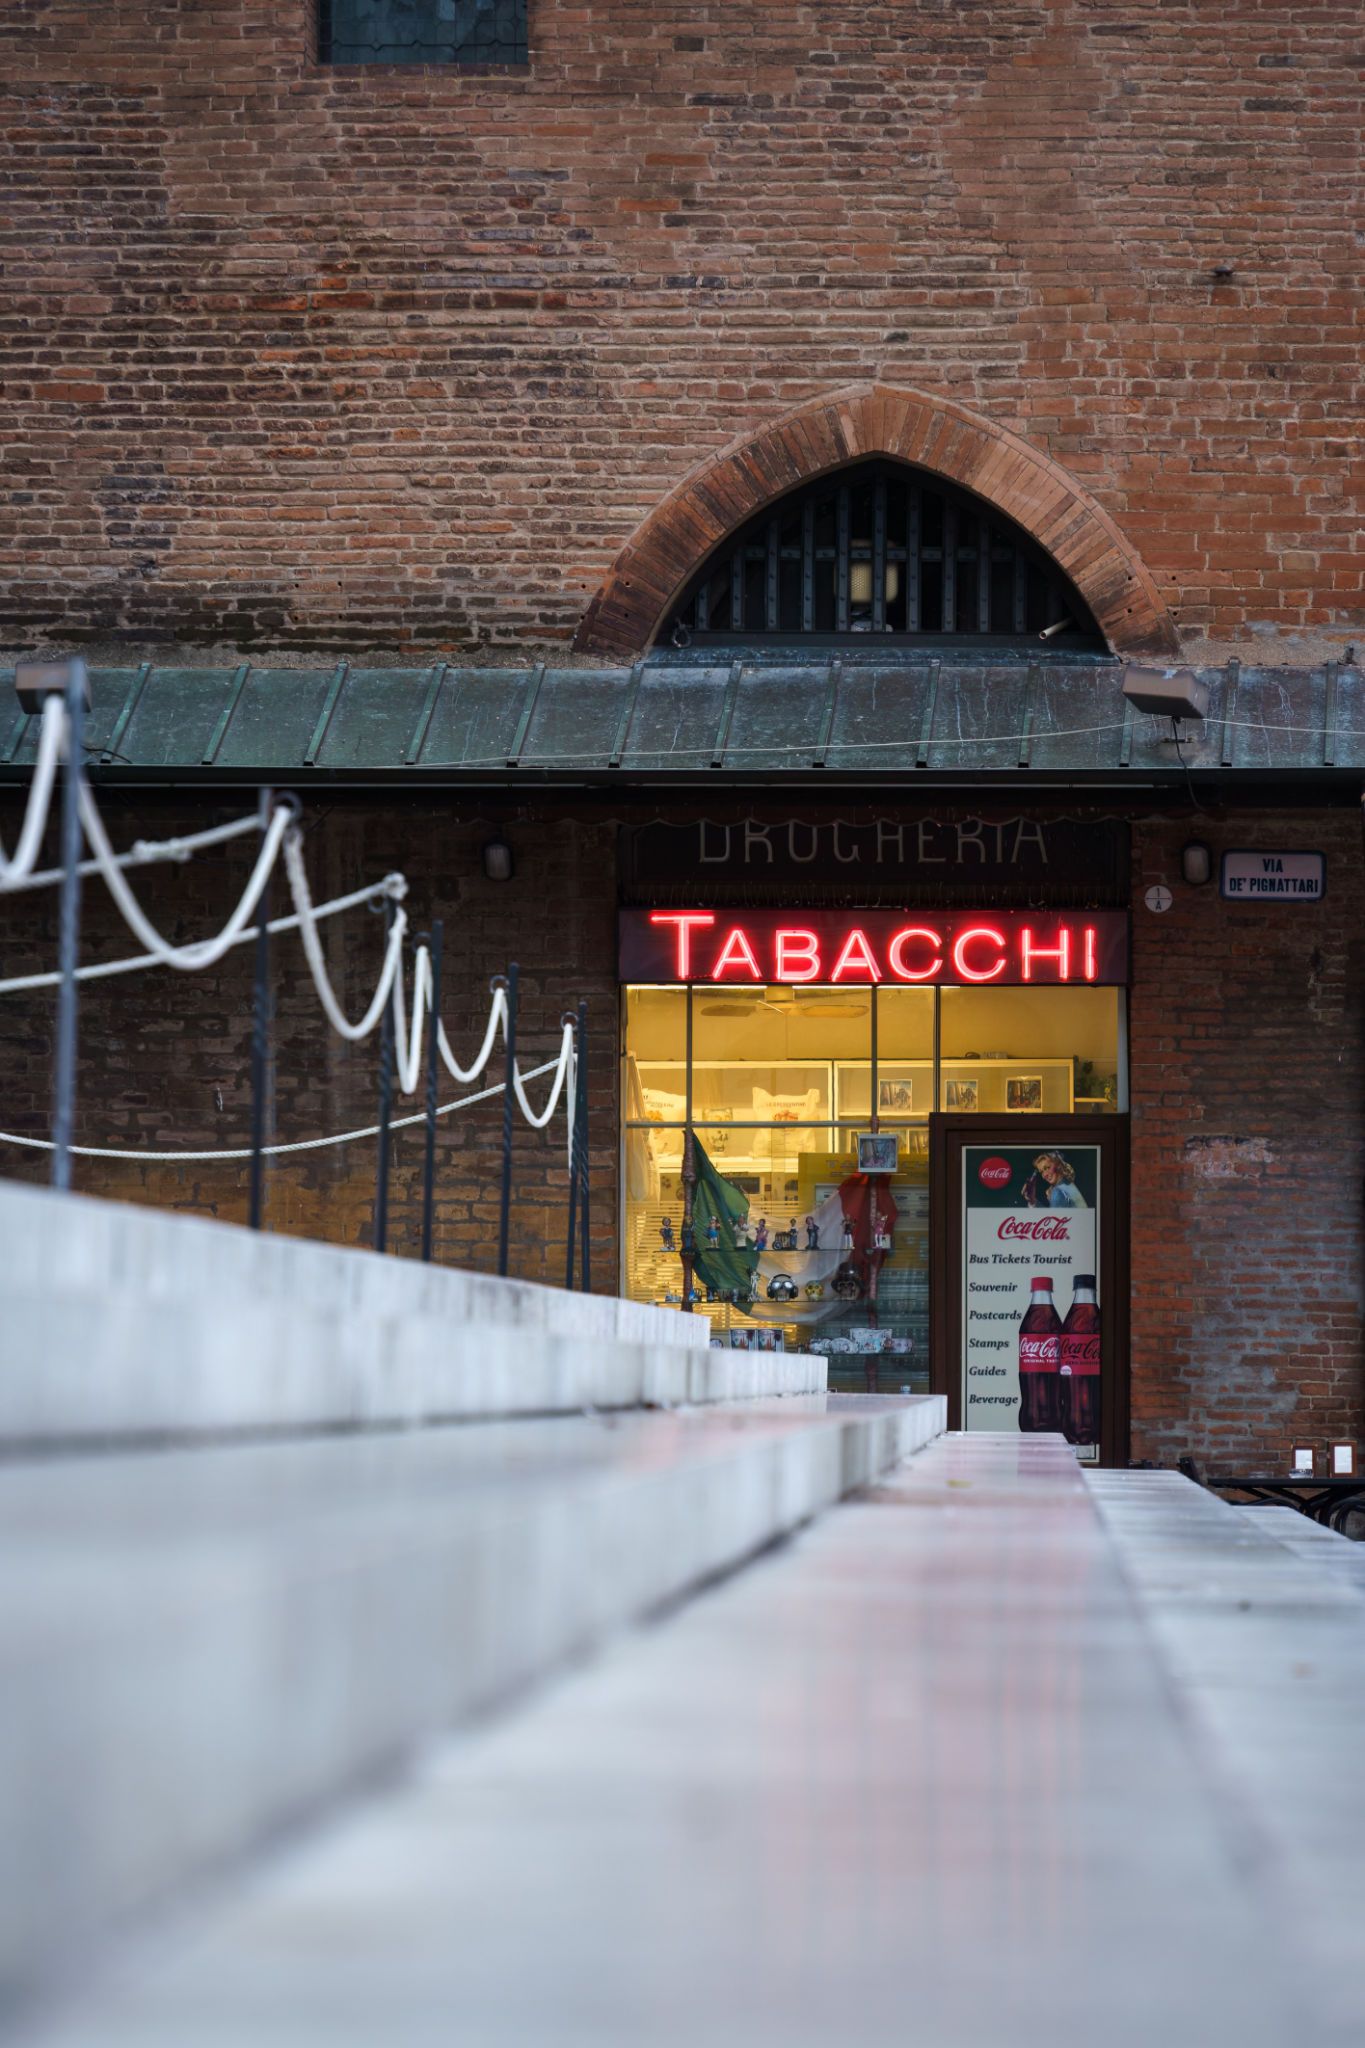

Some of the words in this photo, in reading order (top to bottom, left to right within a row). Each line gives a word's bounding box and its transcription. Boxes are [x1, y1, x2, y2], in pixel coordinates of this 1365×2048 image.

[1262, 858, 1284, 873] VIA
[1229, 877, 1247, 892] DE'
[1249, 878, 1319, 893] PIGNATTARI
[1154, 899, 1162, 911] A
[650, 914, 1096, 983] TABACCHI
[997, 1216, 1072, 1240] Coca-Cola
[969, 1254, 989, 1264] Bus
[992, 1254, 1031, 1264] Tickets
[1033, 1254, 1073, 1264] Tourist
[969, 1282, 1018, 1292] Souvenir
[969, 1310, 1022, 1320] Postcards
[969, 1338, 1010, 1351] Stamps
[969, 1366, 1008, 1376] Guides
[969, 1394, 1019, 1407] Beverage
